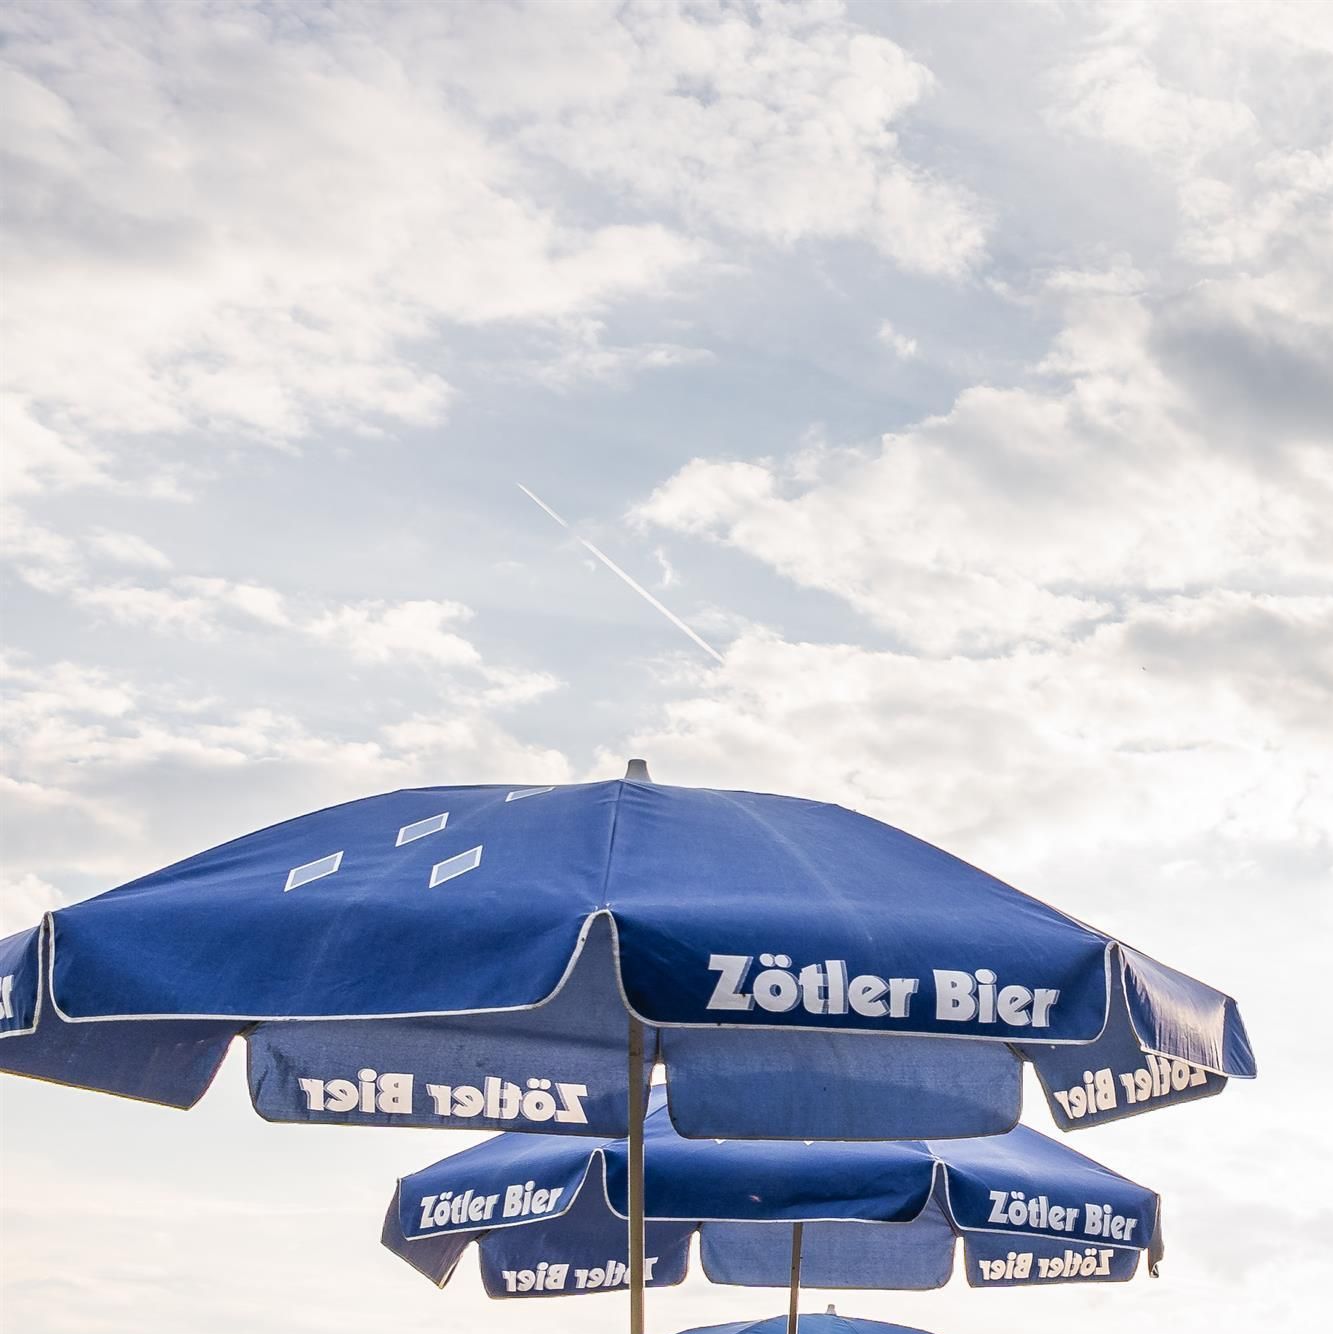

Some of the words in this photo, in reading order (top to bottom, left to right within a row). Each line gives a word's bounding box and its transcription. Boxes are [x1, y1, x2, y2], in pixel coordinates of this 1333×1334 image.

[706, 953, 918, 1018] Zötler
[932, 968, 1061, 1028] Bier
[419, 1189, 500, 1229] Zötler
[502, 1180, 564, 1218] Bier
[987, 1190, 1080, 1232] Zötler
[1084, 1203, 1139, 1241] Bier
